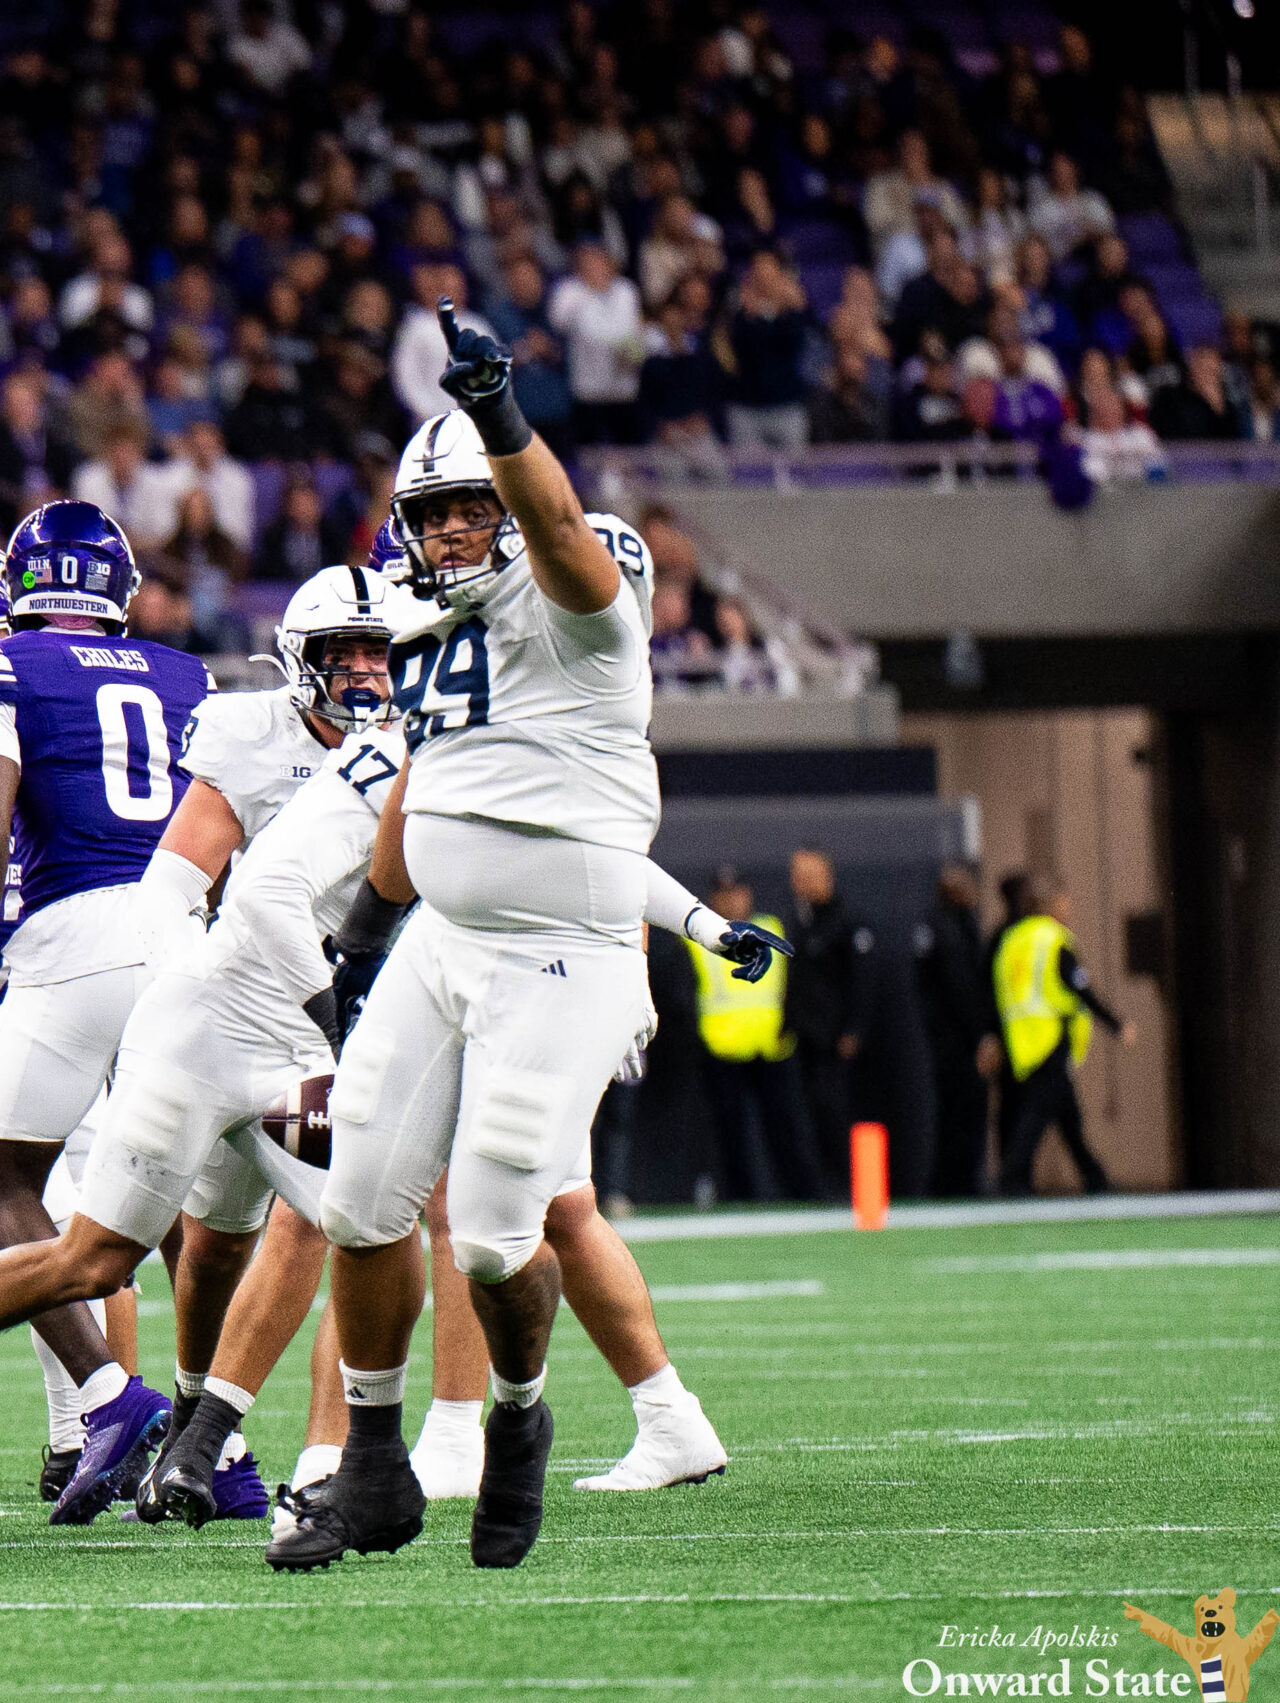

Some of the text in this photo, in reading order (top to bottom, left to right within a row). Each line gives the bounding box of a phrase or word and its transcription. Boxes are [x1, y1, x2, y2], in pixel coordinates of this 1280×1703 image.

[61, 555, 78, 584] 0
[28, 598, 109, 614] NORTHWESTERN
[69, 645, 151, 673] CHILES
[96, 683, 174, 822] 0
[337, 744, 400, 797] 17
